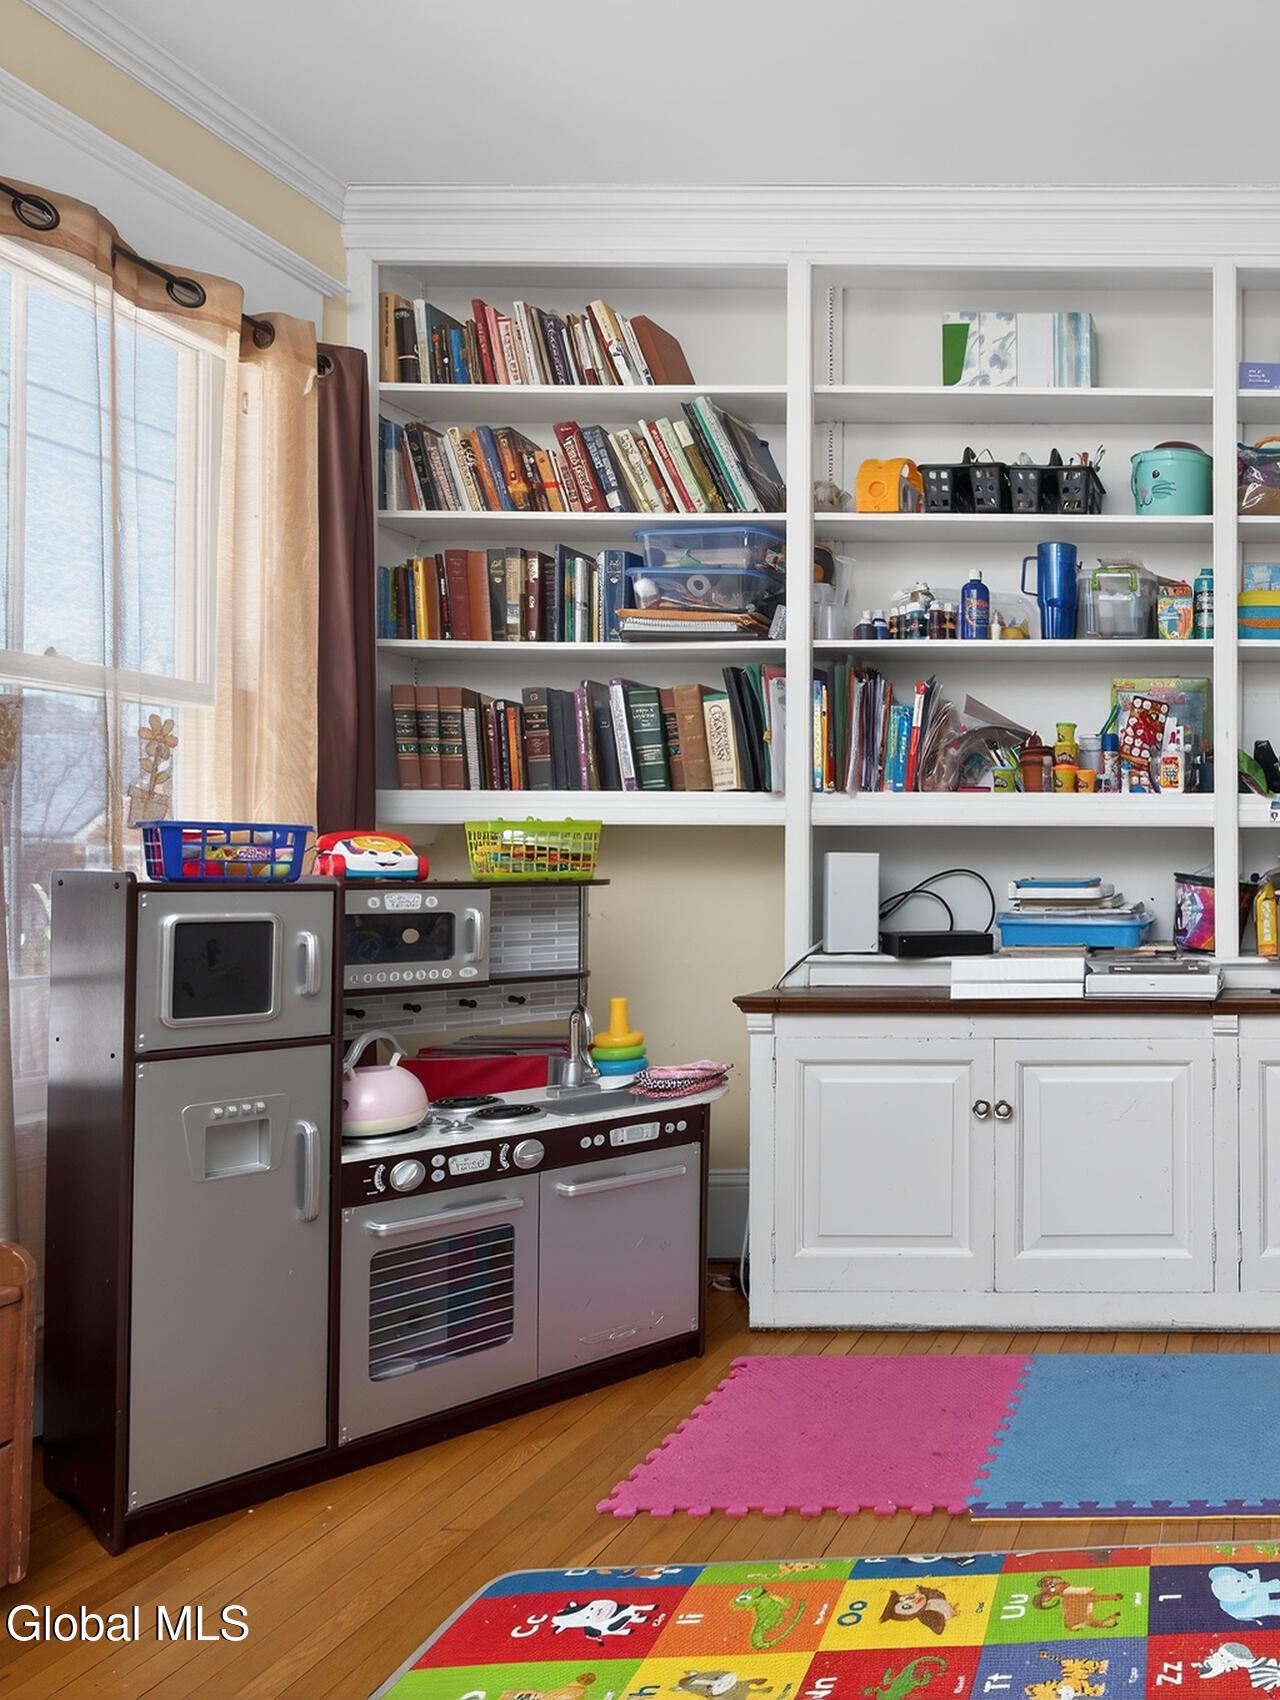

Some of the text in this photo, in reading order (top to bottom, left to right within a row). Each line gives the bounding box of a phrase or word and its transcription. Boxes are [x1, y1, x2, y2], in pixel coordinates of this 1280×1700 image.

[1000, 1593, 1030, 1620] Uu
[1158, 1594, 1183, 1603] 1
[510, 1613, 549, 1638] Cc
[837, 1600, 868, 1626] Oo
[983, 1671, 1013, 1693] Tt
[1156, 1660, 1184, 1687] Zz
